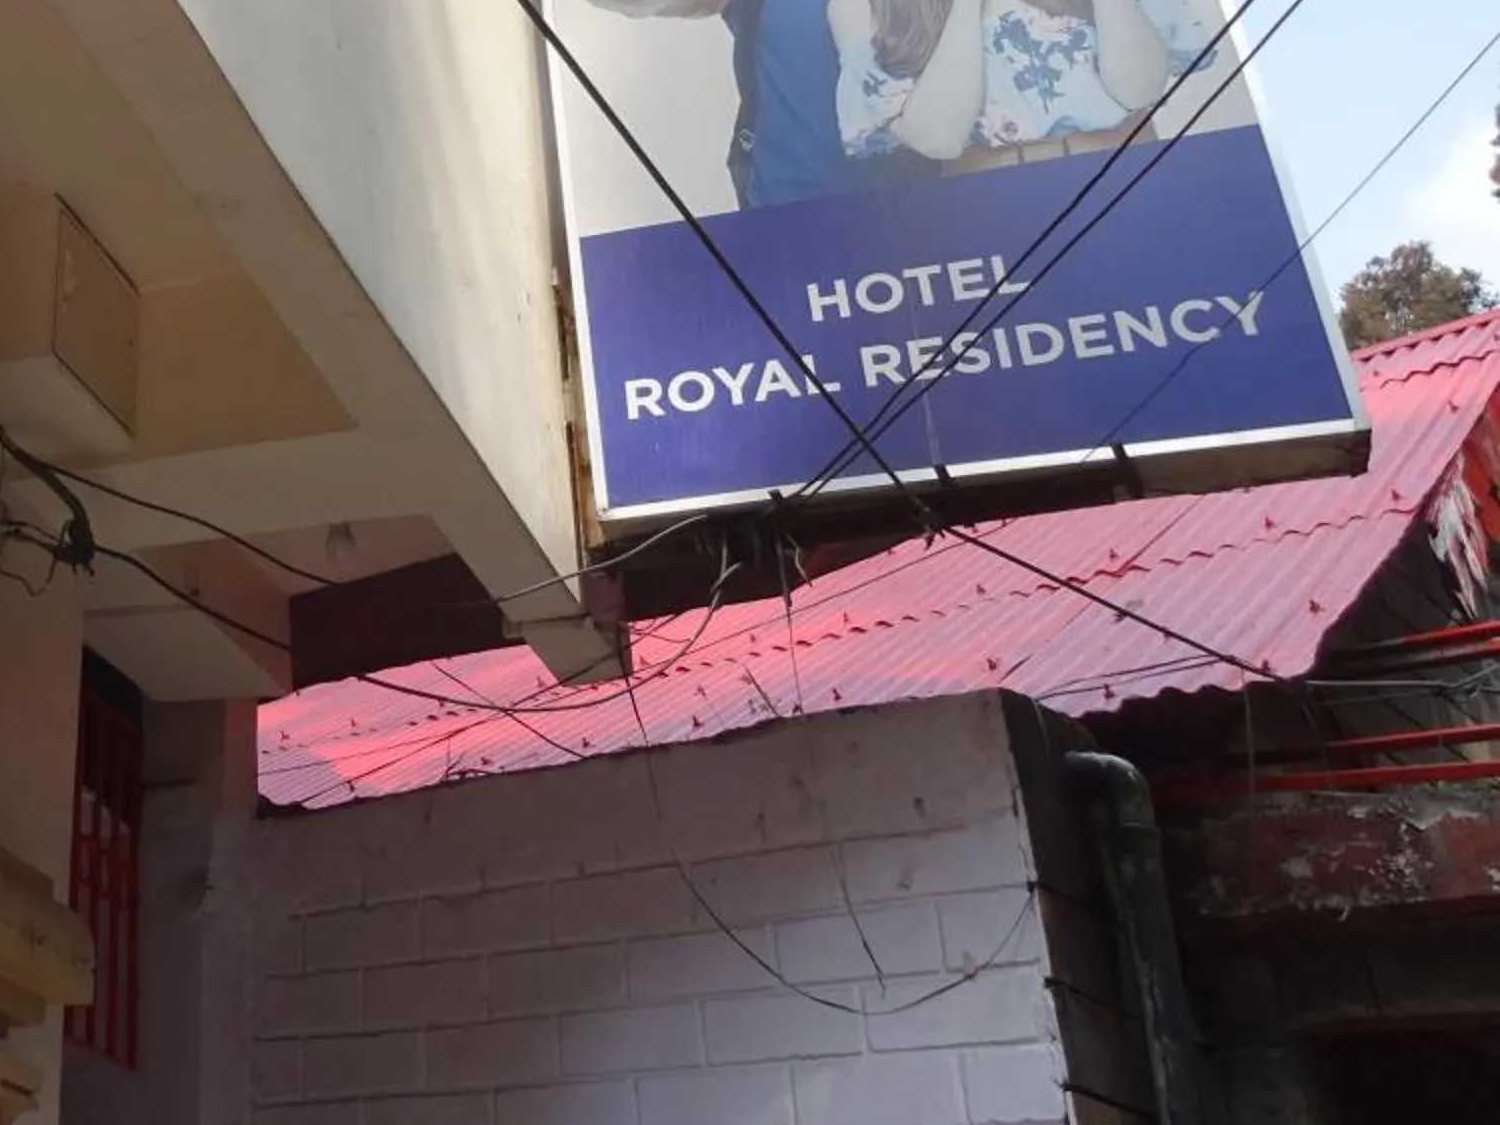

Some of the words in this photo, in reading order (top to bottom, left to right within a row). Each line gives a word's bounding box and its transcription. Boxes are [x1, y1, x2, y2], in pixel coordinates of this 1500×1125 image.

[807, 255, 1030, 322] HOTEL
[624, 355, 841, 420] ROYAL
[860, 291, 1264, 387] RESIDENCY
